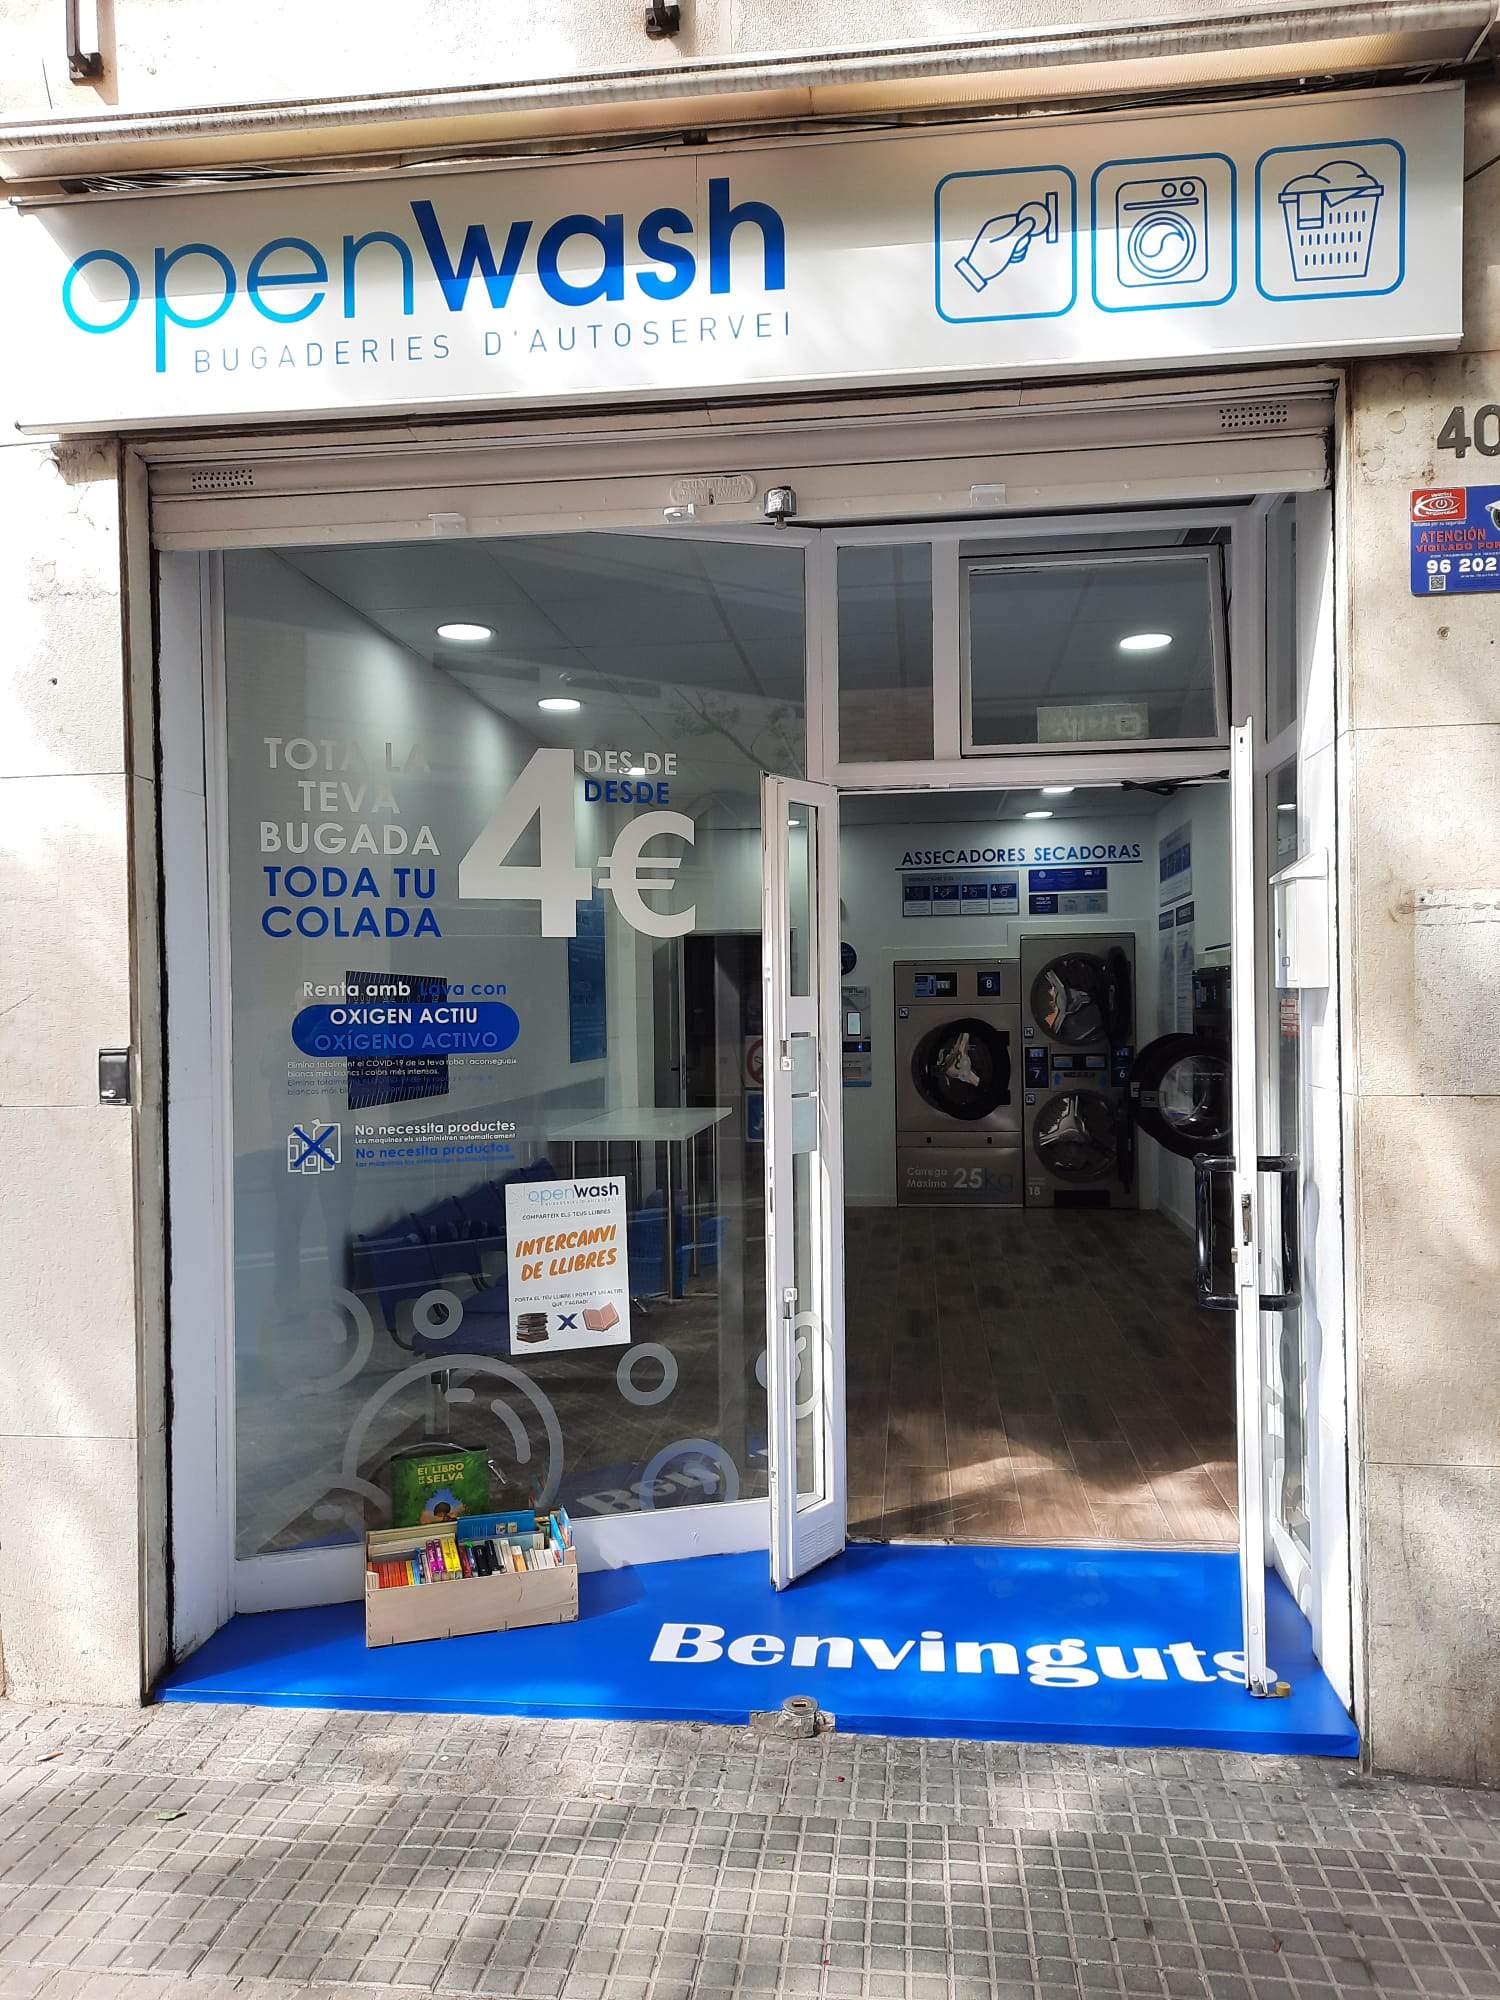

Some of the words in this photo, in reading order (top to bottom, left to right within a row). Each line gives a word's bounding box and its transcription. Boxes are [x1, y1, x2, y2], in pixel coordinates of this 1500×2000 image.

[62, 176, 786, 373] openwash
[194, 334, 451, 374] BUGADERIES
[484, 311, 791, 357] D'AUTOSERVEI
[1436, 405, 1500, 460] 40
[1421, 527, 1487, 543] ATENCIÓN
[1416, 543, 1473, 553] VIGILADO
[1427, 559, 1452, 574] 96
[1459, 557, 1497, 573] 202
[584, 750, 632, 775] DES
[643, 752, 678, 777] DE
[298, 780, 401, 815] TEVA
[584, 779, 670, 805] DESDE
[259, 821, 441, 856] BUGADA
[901, 848, 1026, 867] ASSECADORES
[1033, 843, 1141, 862] SECADORAS
[263, 866, 381, 898] TODA
[393, 867, 437, 900] TU
[261, 906, 443, 939] COLADA
[303, 981, 360, 997] Renta
[366, 980, 411, 997] amb
[472, 982, 507, 996] con
[330, 1007, 413, 1025] OXIGEN
[419, 1007, 479, 1024] ACTIU
[314, 1029, 415, 1051] OXÍGENO
[422, 1031, 499, 1049] ACTIVO
[366, 1059, 404, 1067] COVID-19
[1033, 1068, 1041, 1080] 7
[355, 1125, 375, 1136] No
[378, 1122, 444, 1136] necessita
[447, 1120, 516, 1135] productes
[356, 1148, 375, 1159] No
[379, 1145, 438, 1158] necesita
[528, 1182, 620, 1206] openwash
[515, 1224, 617, 1258] INTERCANVI
[521, 1261, 544, 1282] DE
[549, 1247, 618, 1277] LLIBRES
[426, 1471, 465, 1485] SELVA
[432, 1462, 465, 1474] LIBRO
[648, 1622, 1278, 1690] Benvinguts
